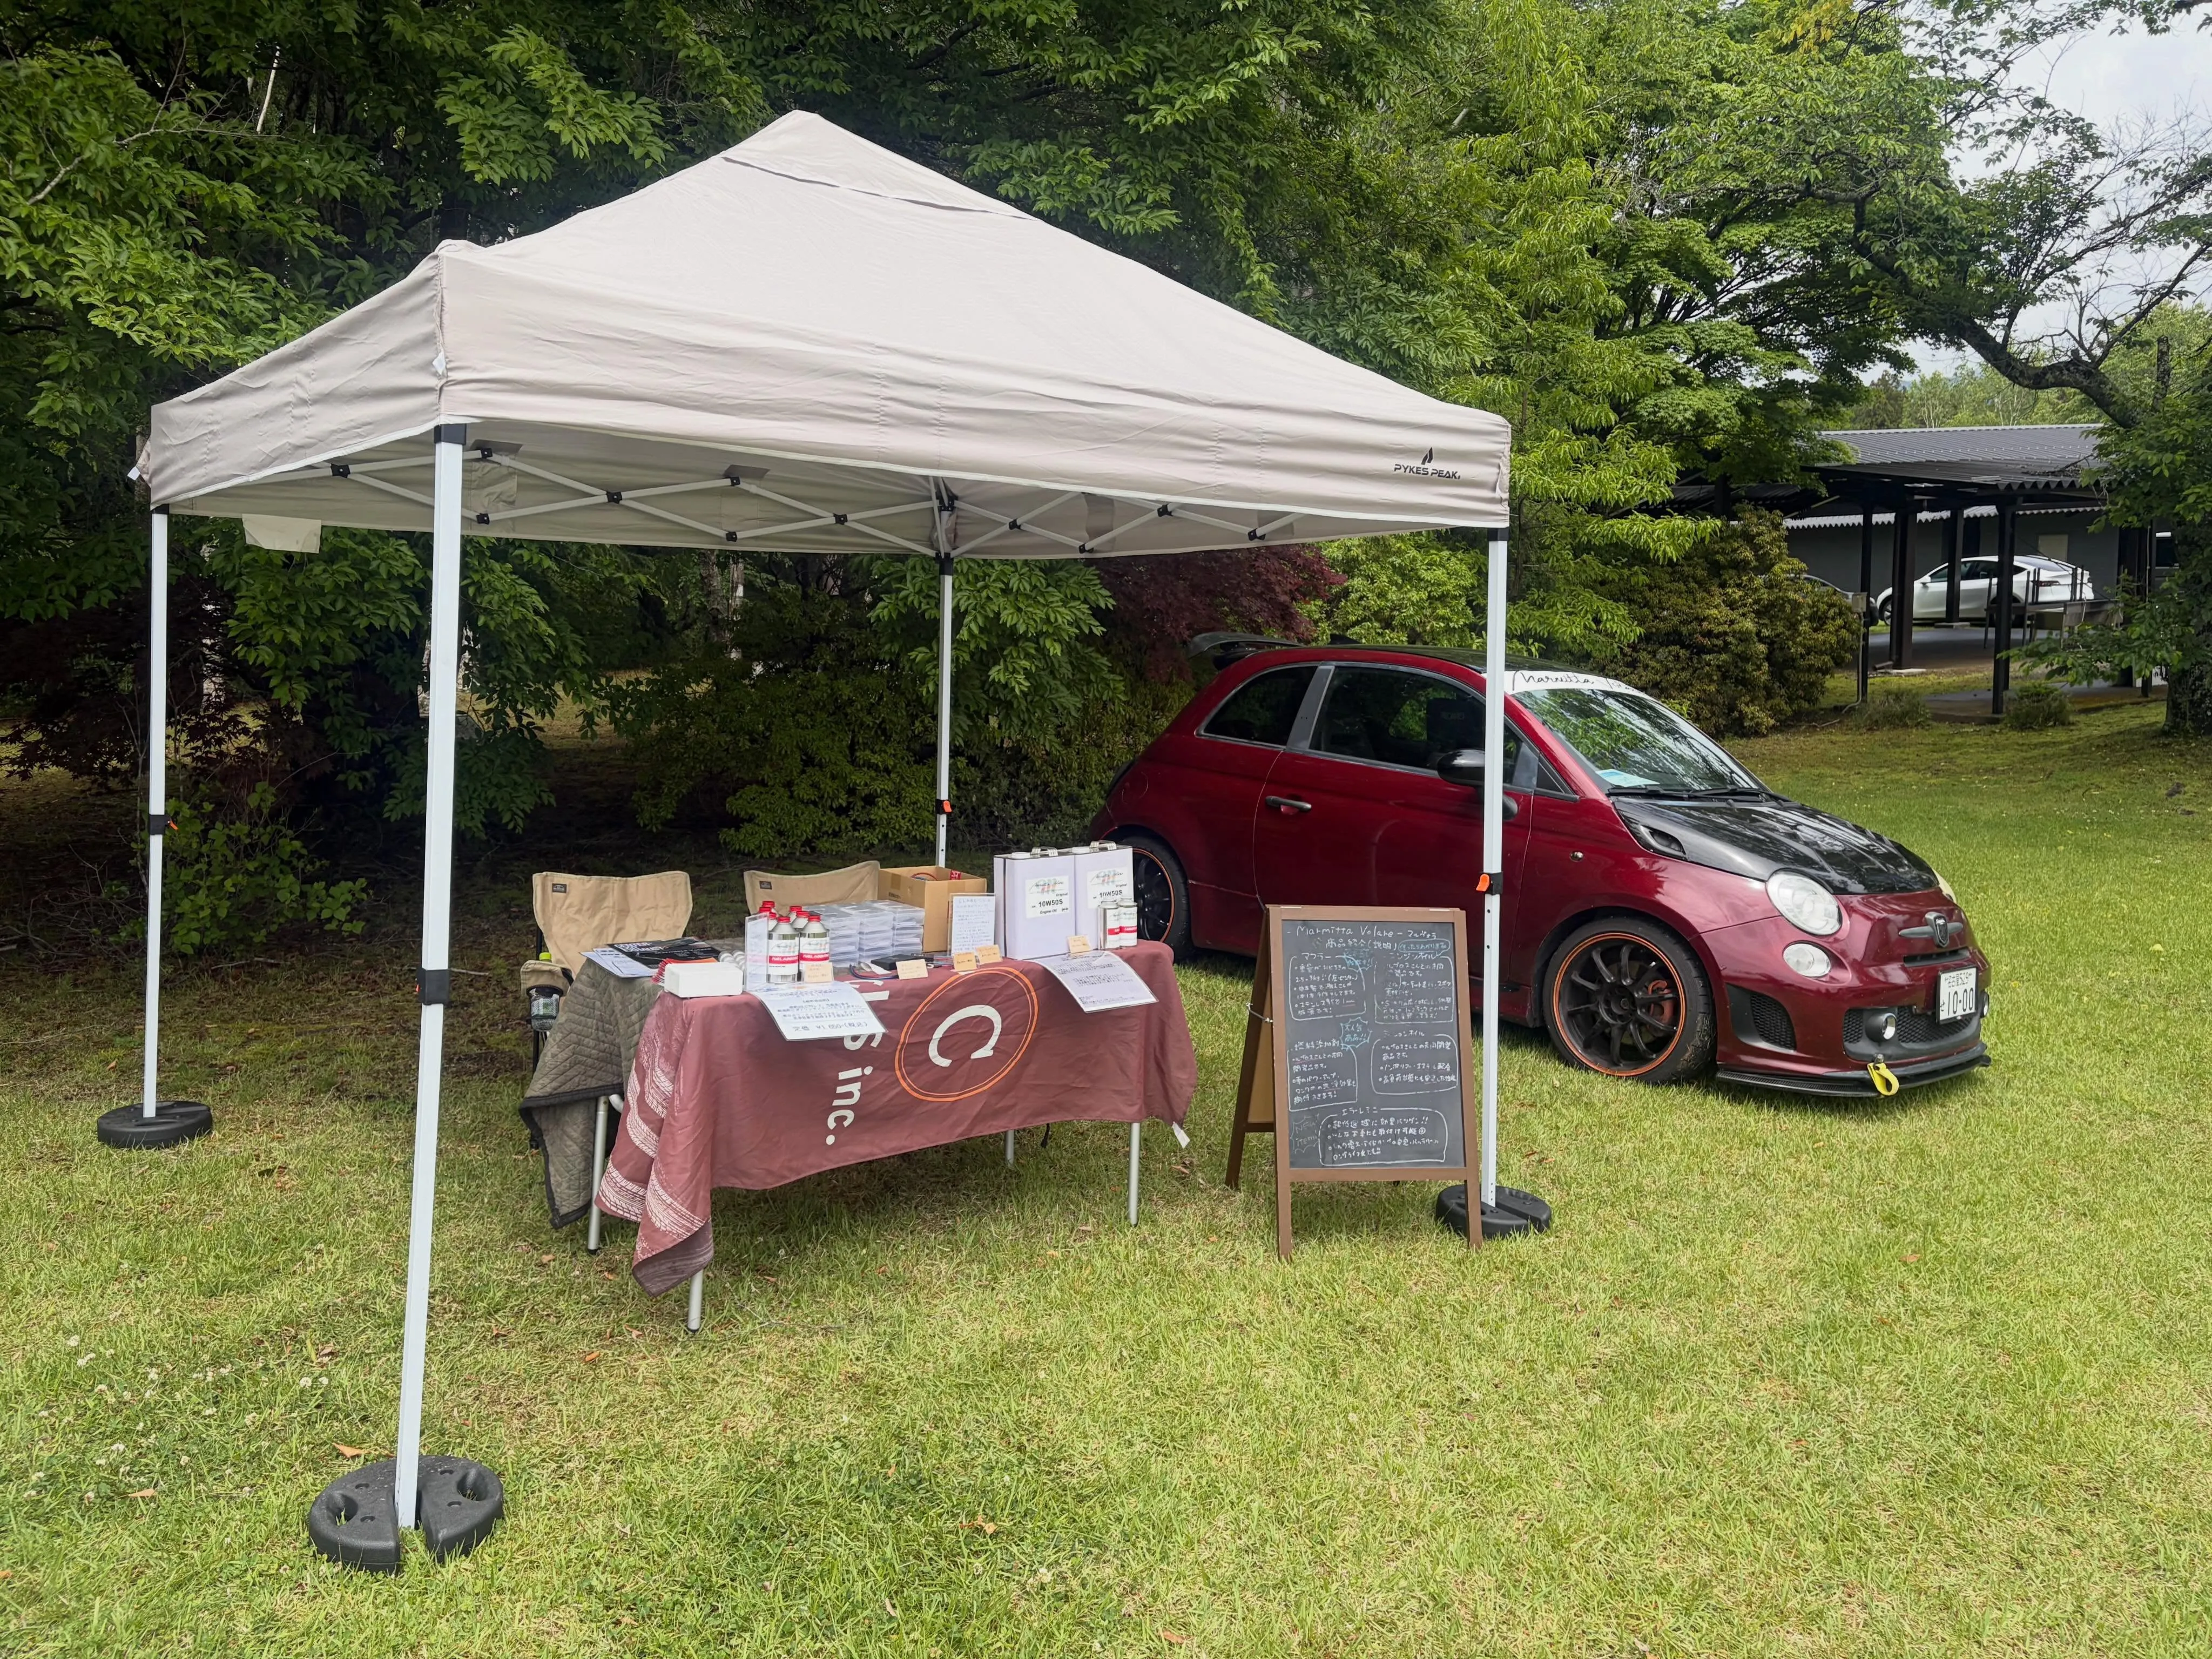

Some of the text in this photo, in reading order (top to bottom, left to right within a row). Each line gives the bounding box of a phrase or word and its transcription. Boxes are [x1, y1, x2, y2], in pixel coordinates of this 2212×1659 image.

[1394, 463, 1429, 475] PYKES
[1038, 899, 1063, 907] 10W50S
[1297, 926, 1353, 936] Marmitta
[1360, 926, 1393, 938] Volare
[1301, 952, 1331, 960] マフラー
[826, 1065, 873, 1145] inc.
